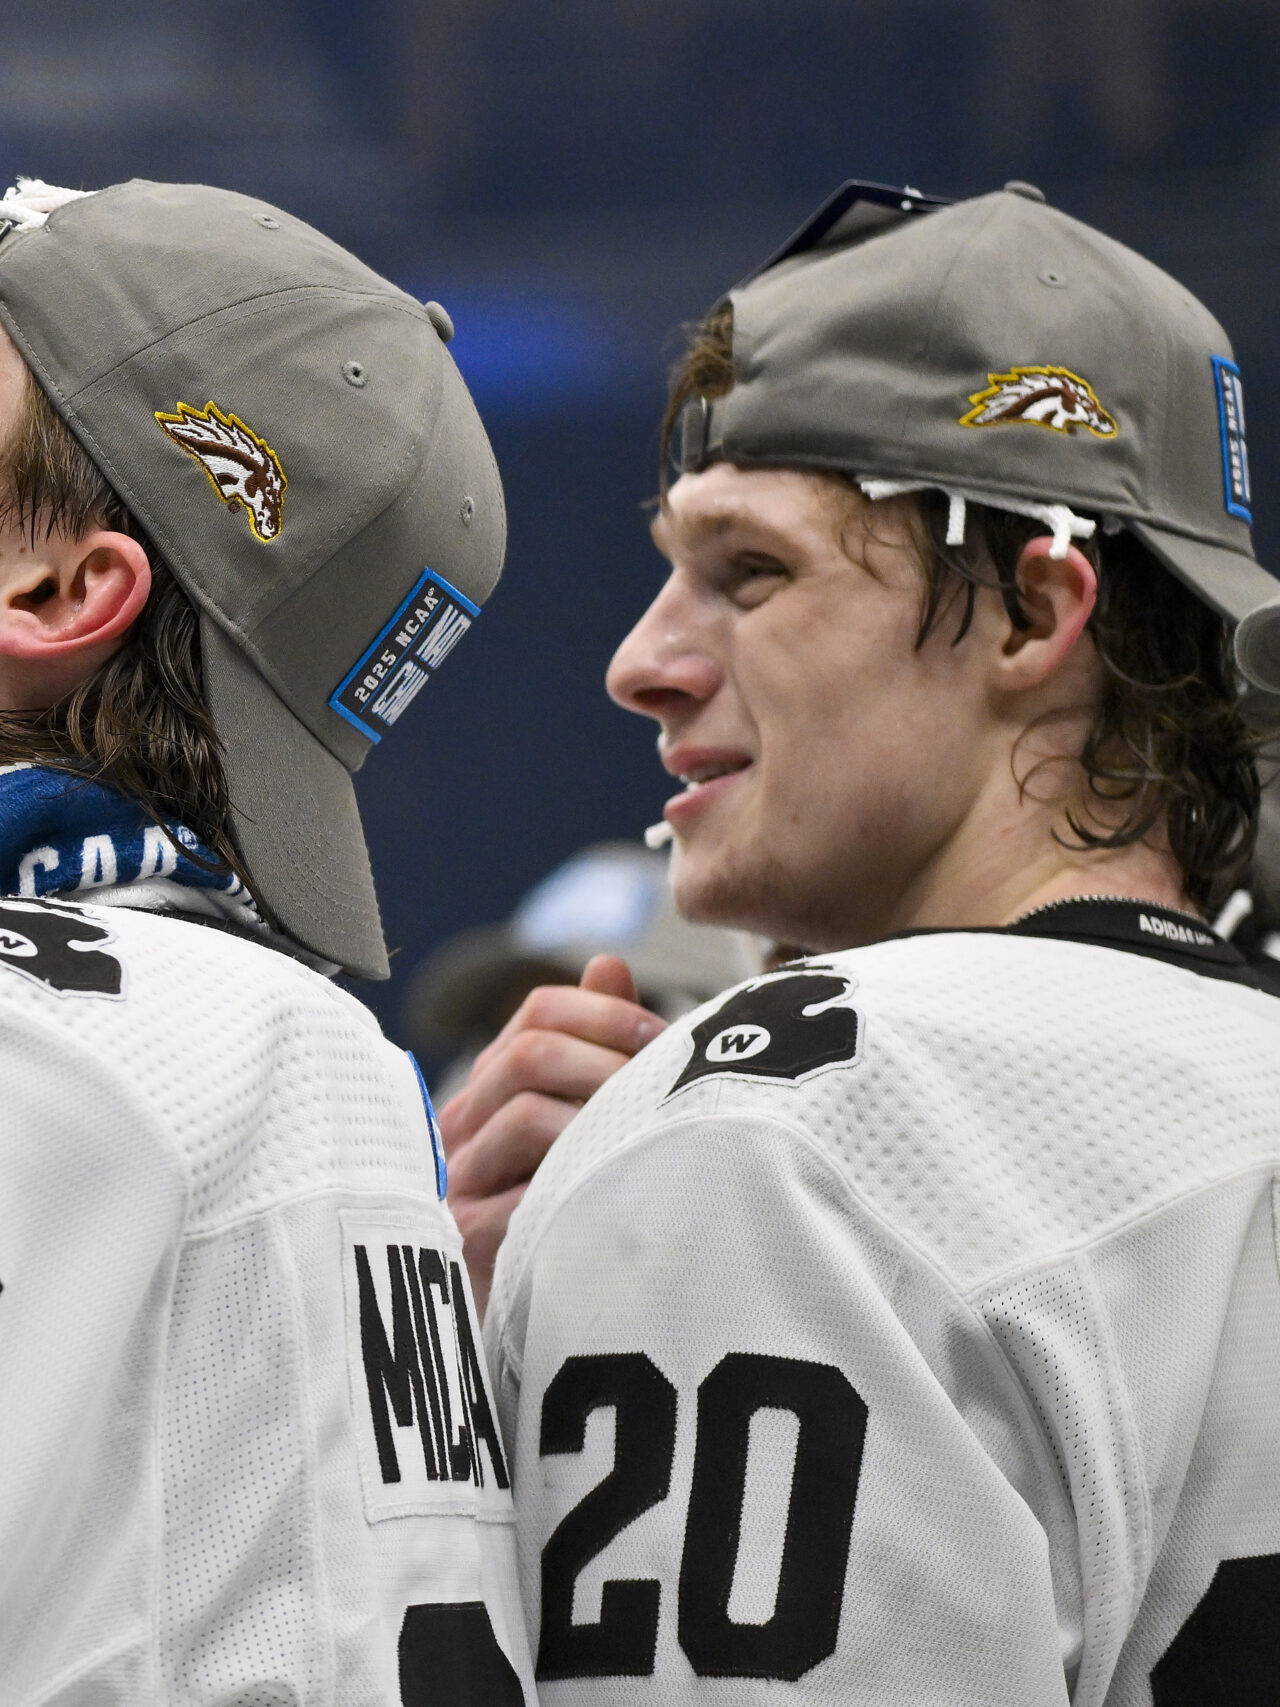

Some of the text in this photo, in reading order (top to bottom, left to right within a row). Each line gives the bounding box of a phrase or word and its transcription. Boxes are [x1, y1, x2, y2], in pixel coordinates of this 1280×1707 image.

[354, 649, 397, 703] 2025
[395, 594, 439, 647] NCAA
[1139, 913, 1195, 945] ADIDAS
[721, 1033, 761, 1054] W
[536, 1351, 869, 1682] 20
